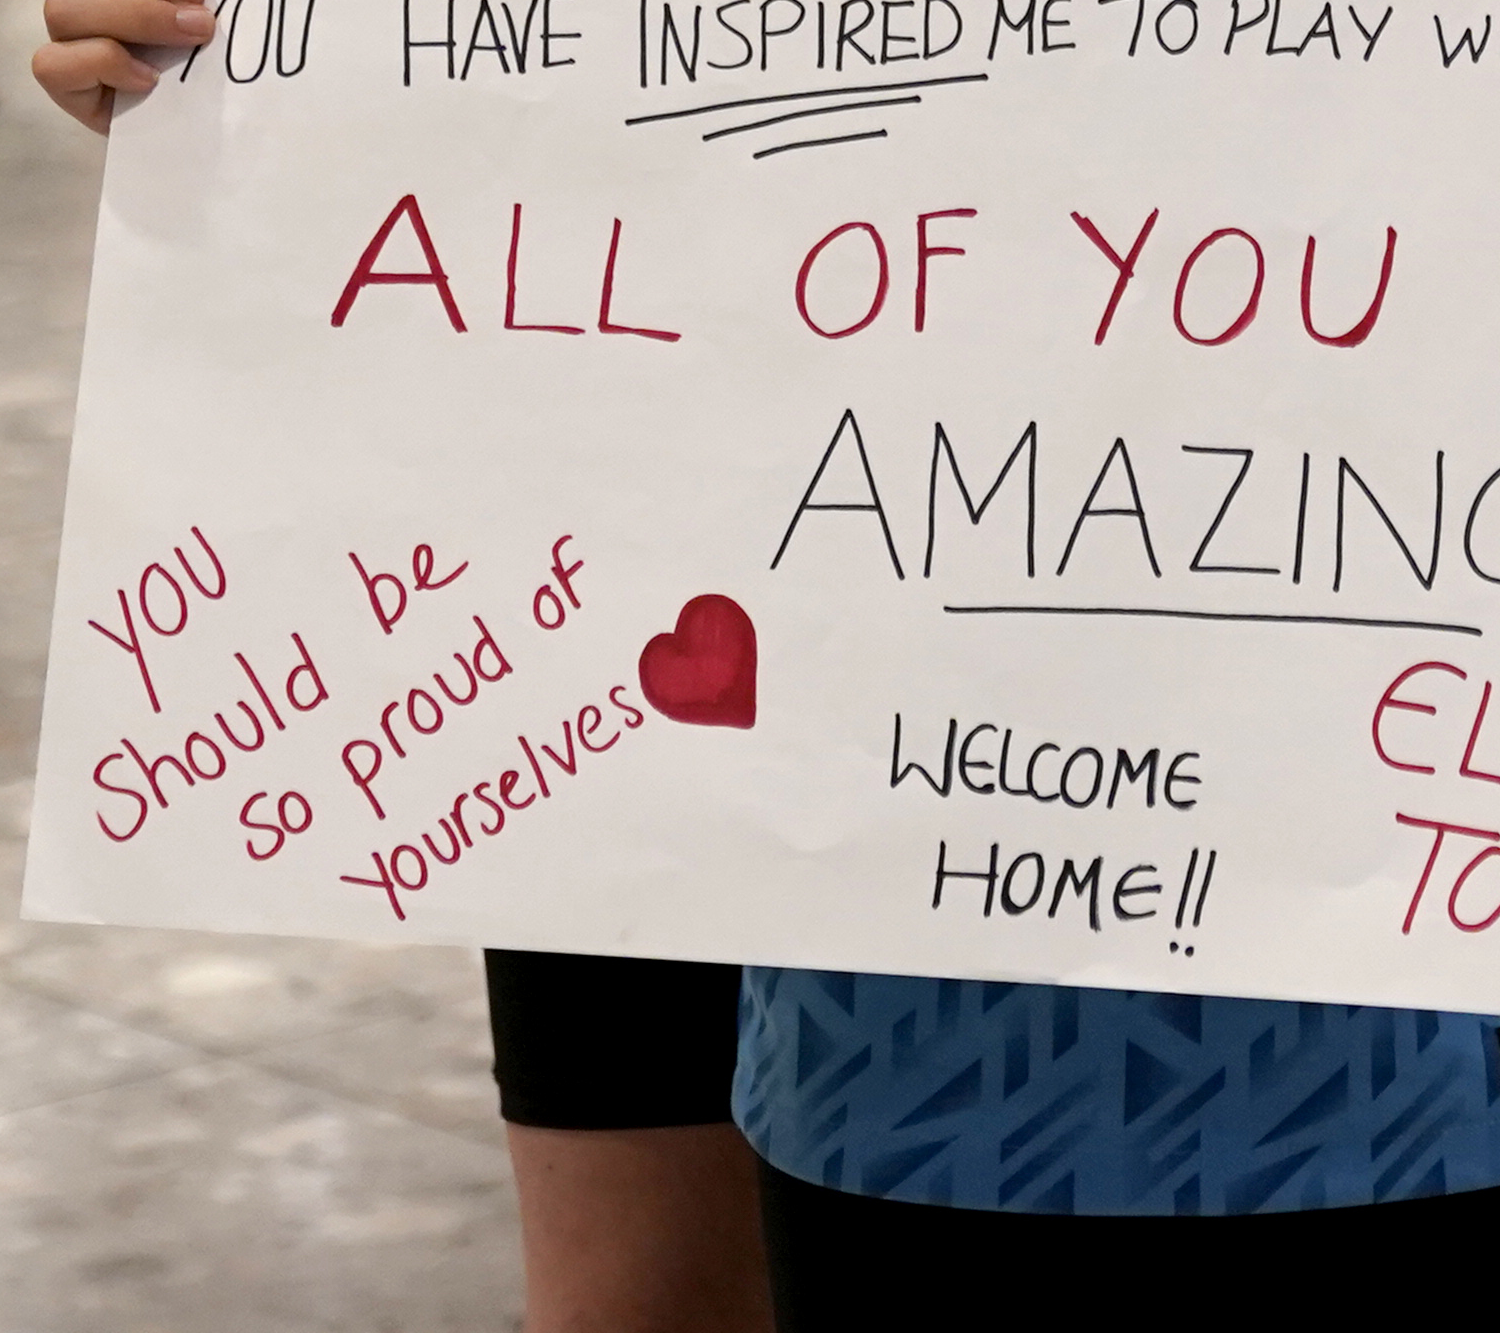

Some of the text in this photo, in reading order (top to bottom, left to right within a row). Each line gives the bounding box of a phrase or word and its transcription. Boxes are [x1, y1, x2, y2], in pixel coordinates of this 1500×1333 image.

[331, 194, 681, 342] ALL
[795, 208, 978, 339] OF
[1070, 208, 1397, 348] YOU
[348, 543, 469, 635] be
[341, 615, 513, 820] proud
[532, 534, 584, 630] of
[339, 685, 645, 921] yourselves
[890, 713, 1202, 810] WELCOME
[932, 840, 1217, 957] HOME!!
